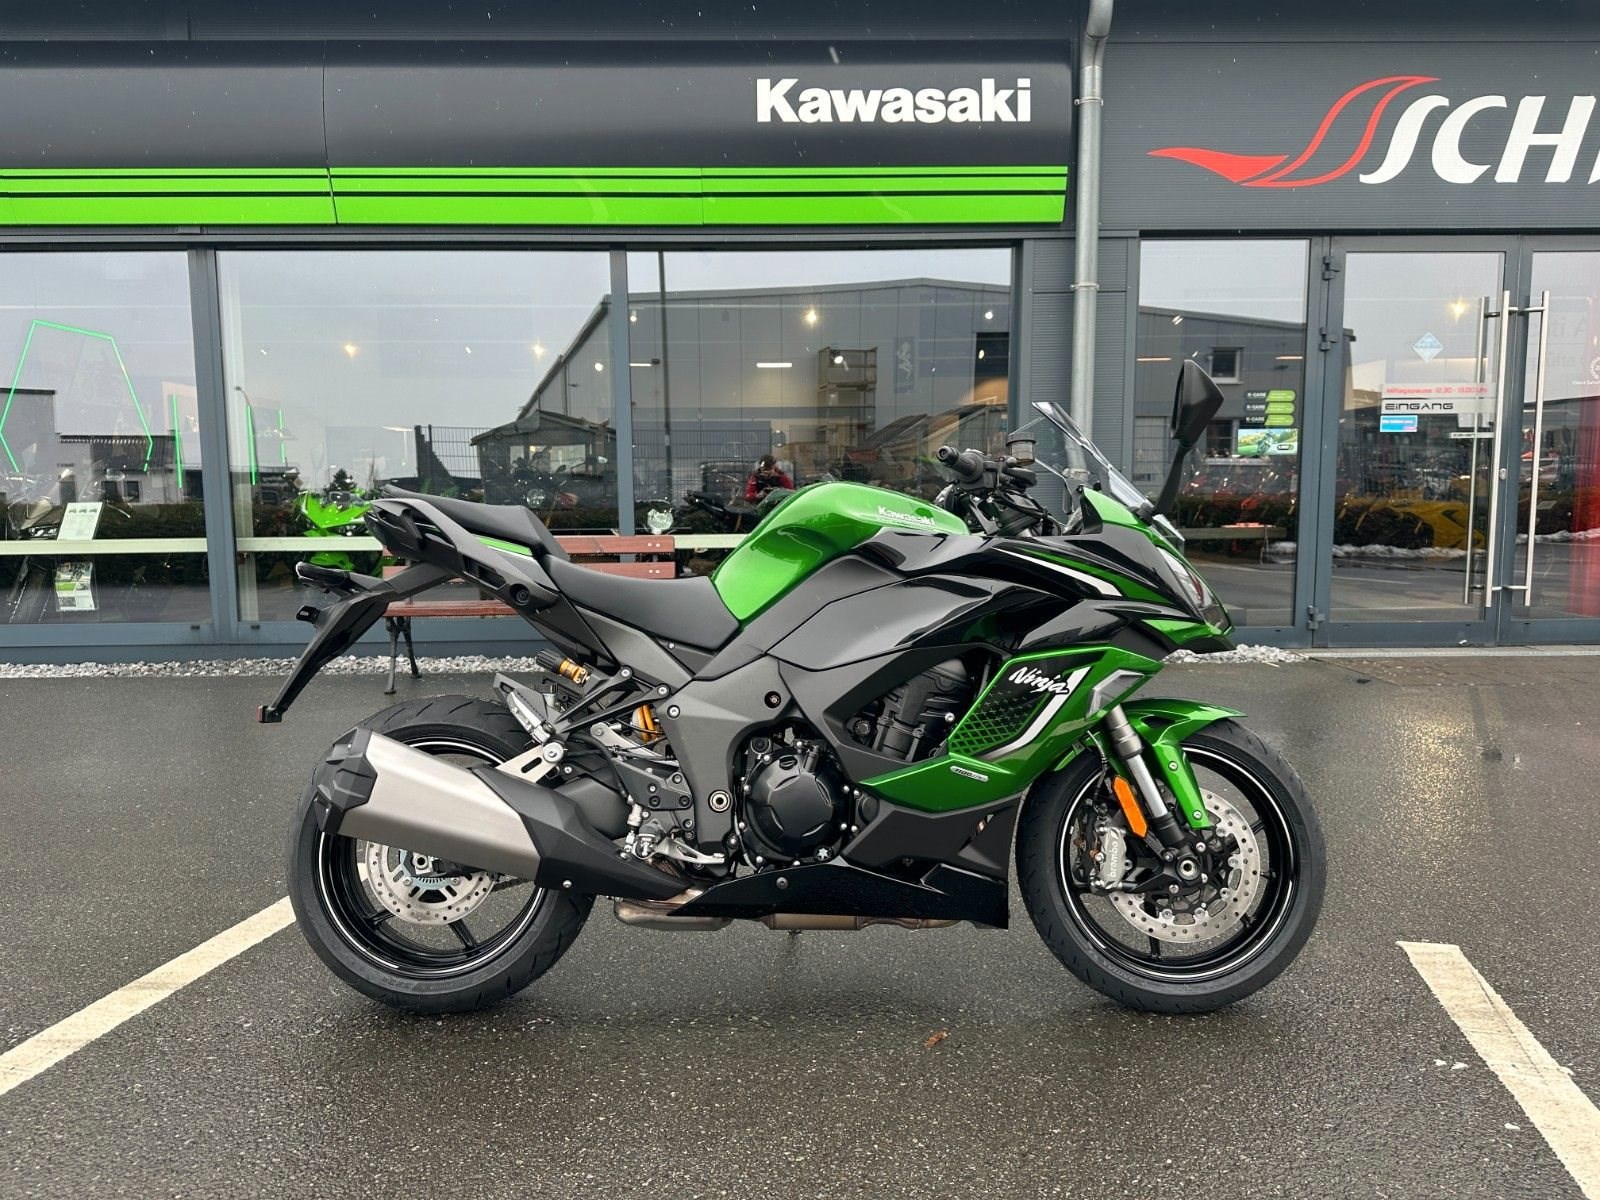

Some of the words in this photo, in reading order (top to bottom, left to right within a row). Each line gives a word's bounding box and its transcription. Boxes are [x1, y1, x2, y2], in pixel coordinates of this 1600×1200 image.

[757, 78, 1031, 123] Kawasaki
[1359, 95, 1600, 184] SCH
[877, 505, 936, 526] Kawasaki
[1008, 667, 1069, 693] Ninja
[1107, 841, 1118, 878] brembo
